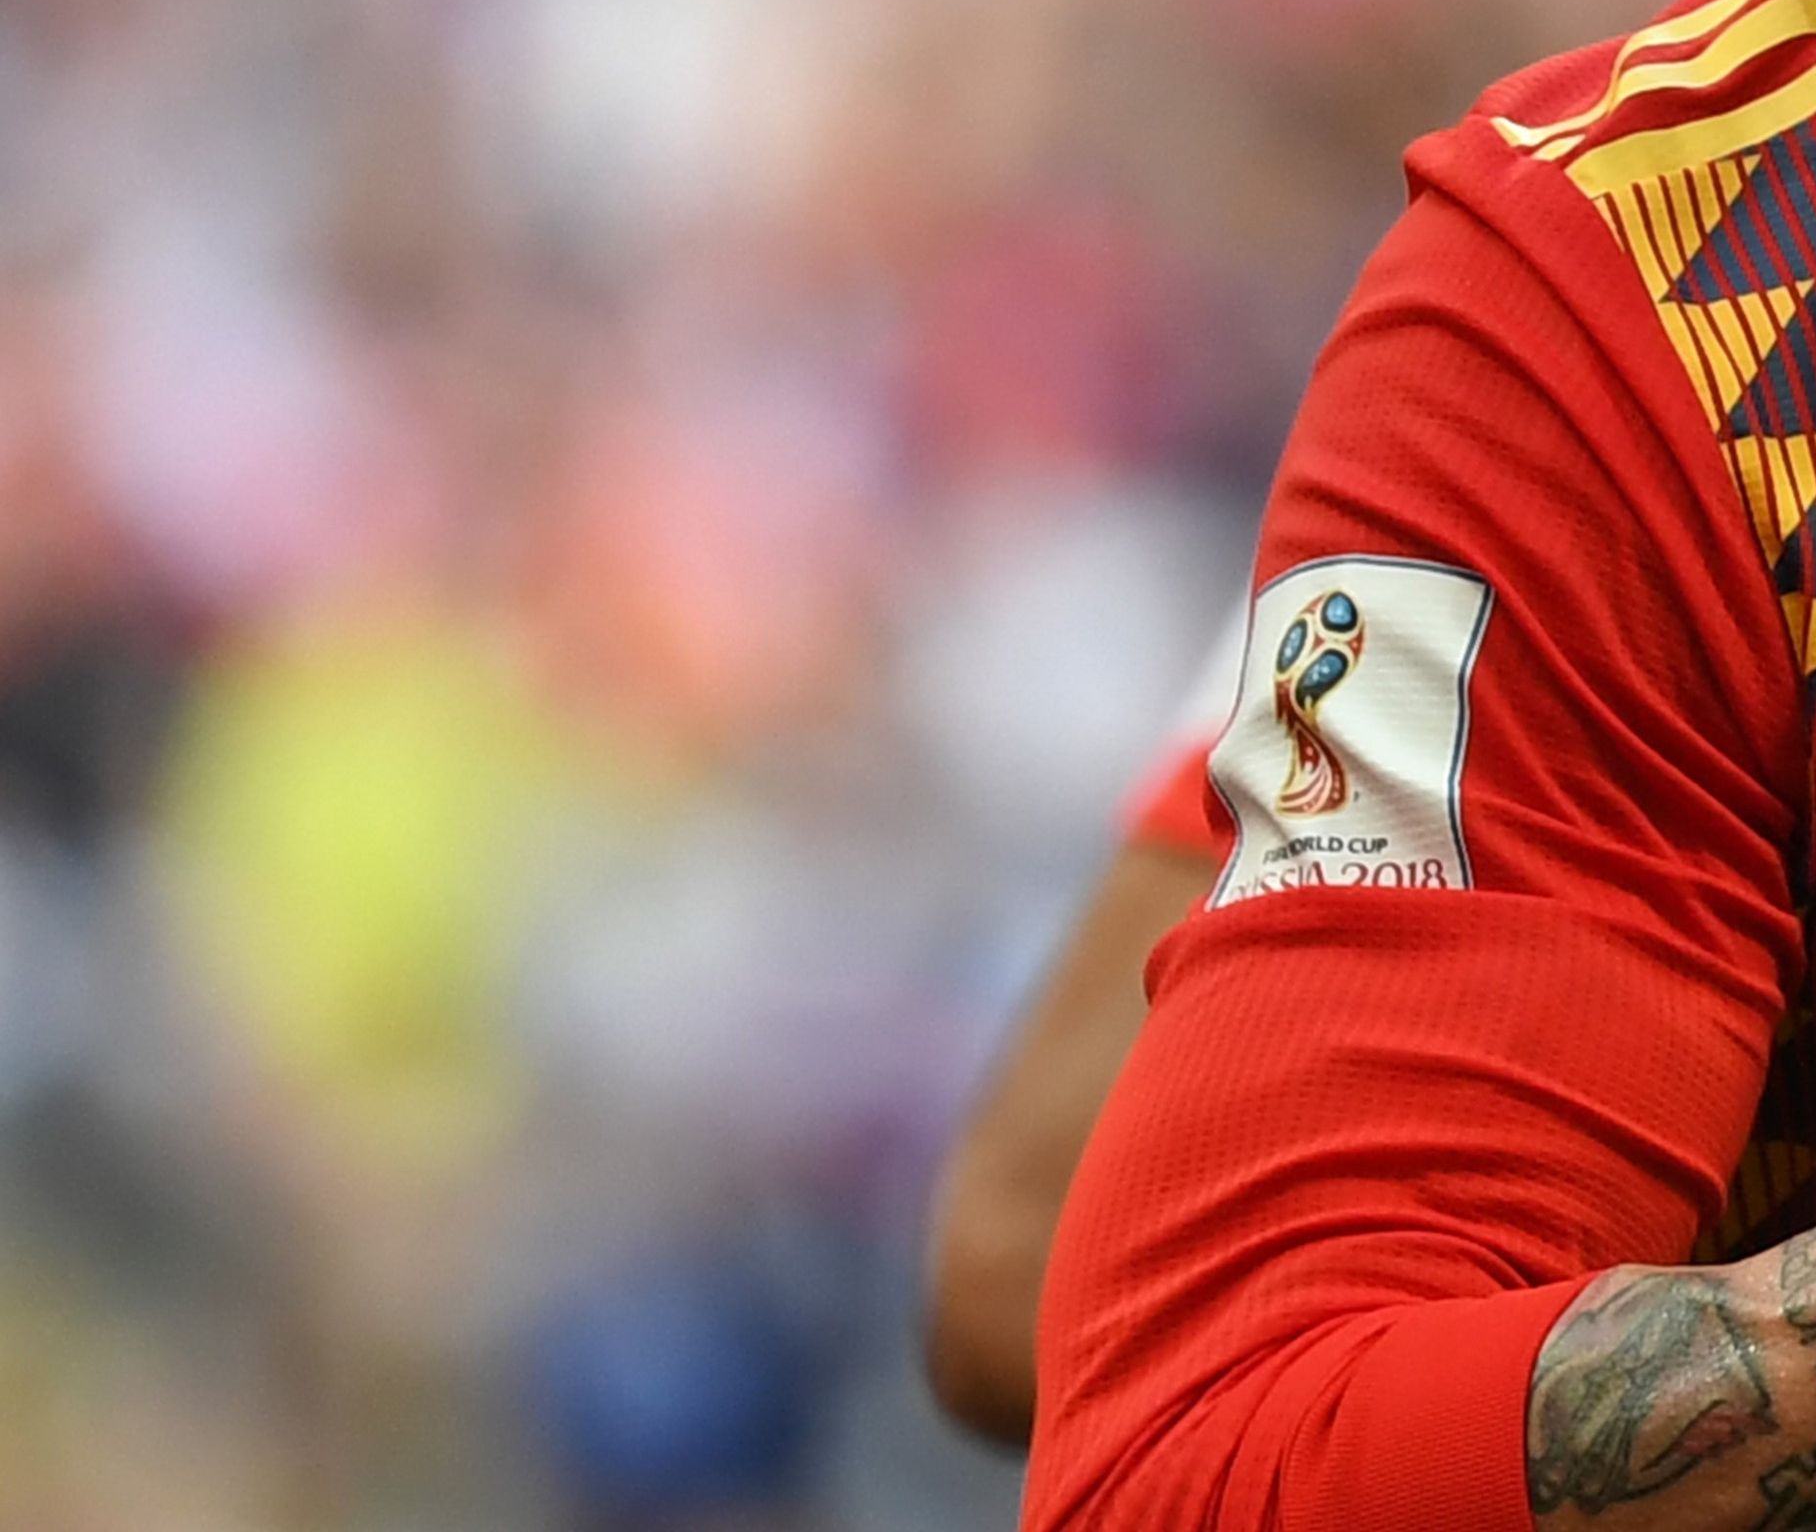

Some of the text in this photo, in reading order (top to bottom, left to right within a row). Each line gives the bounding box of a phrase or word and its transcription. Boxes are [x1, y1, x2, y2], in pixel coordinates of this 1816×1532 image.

[1289, 835, 1344, 857] ORLD
[1347, 837, 1389, 855] CUP
[1340, 858, 1448, 889] 2018
